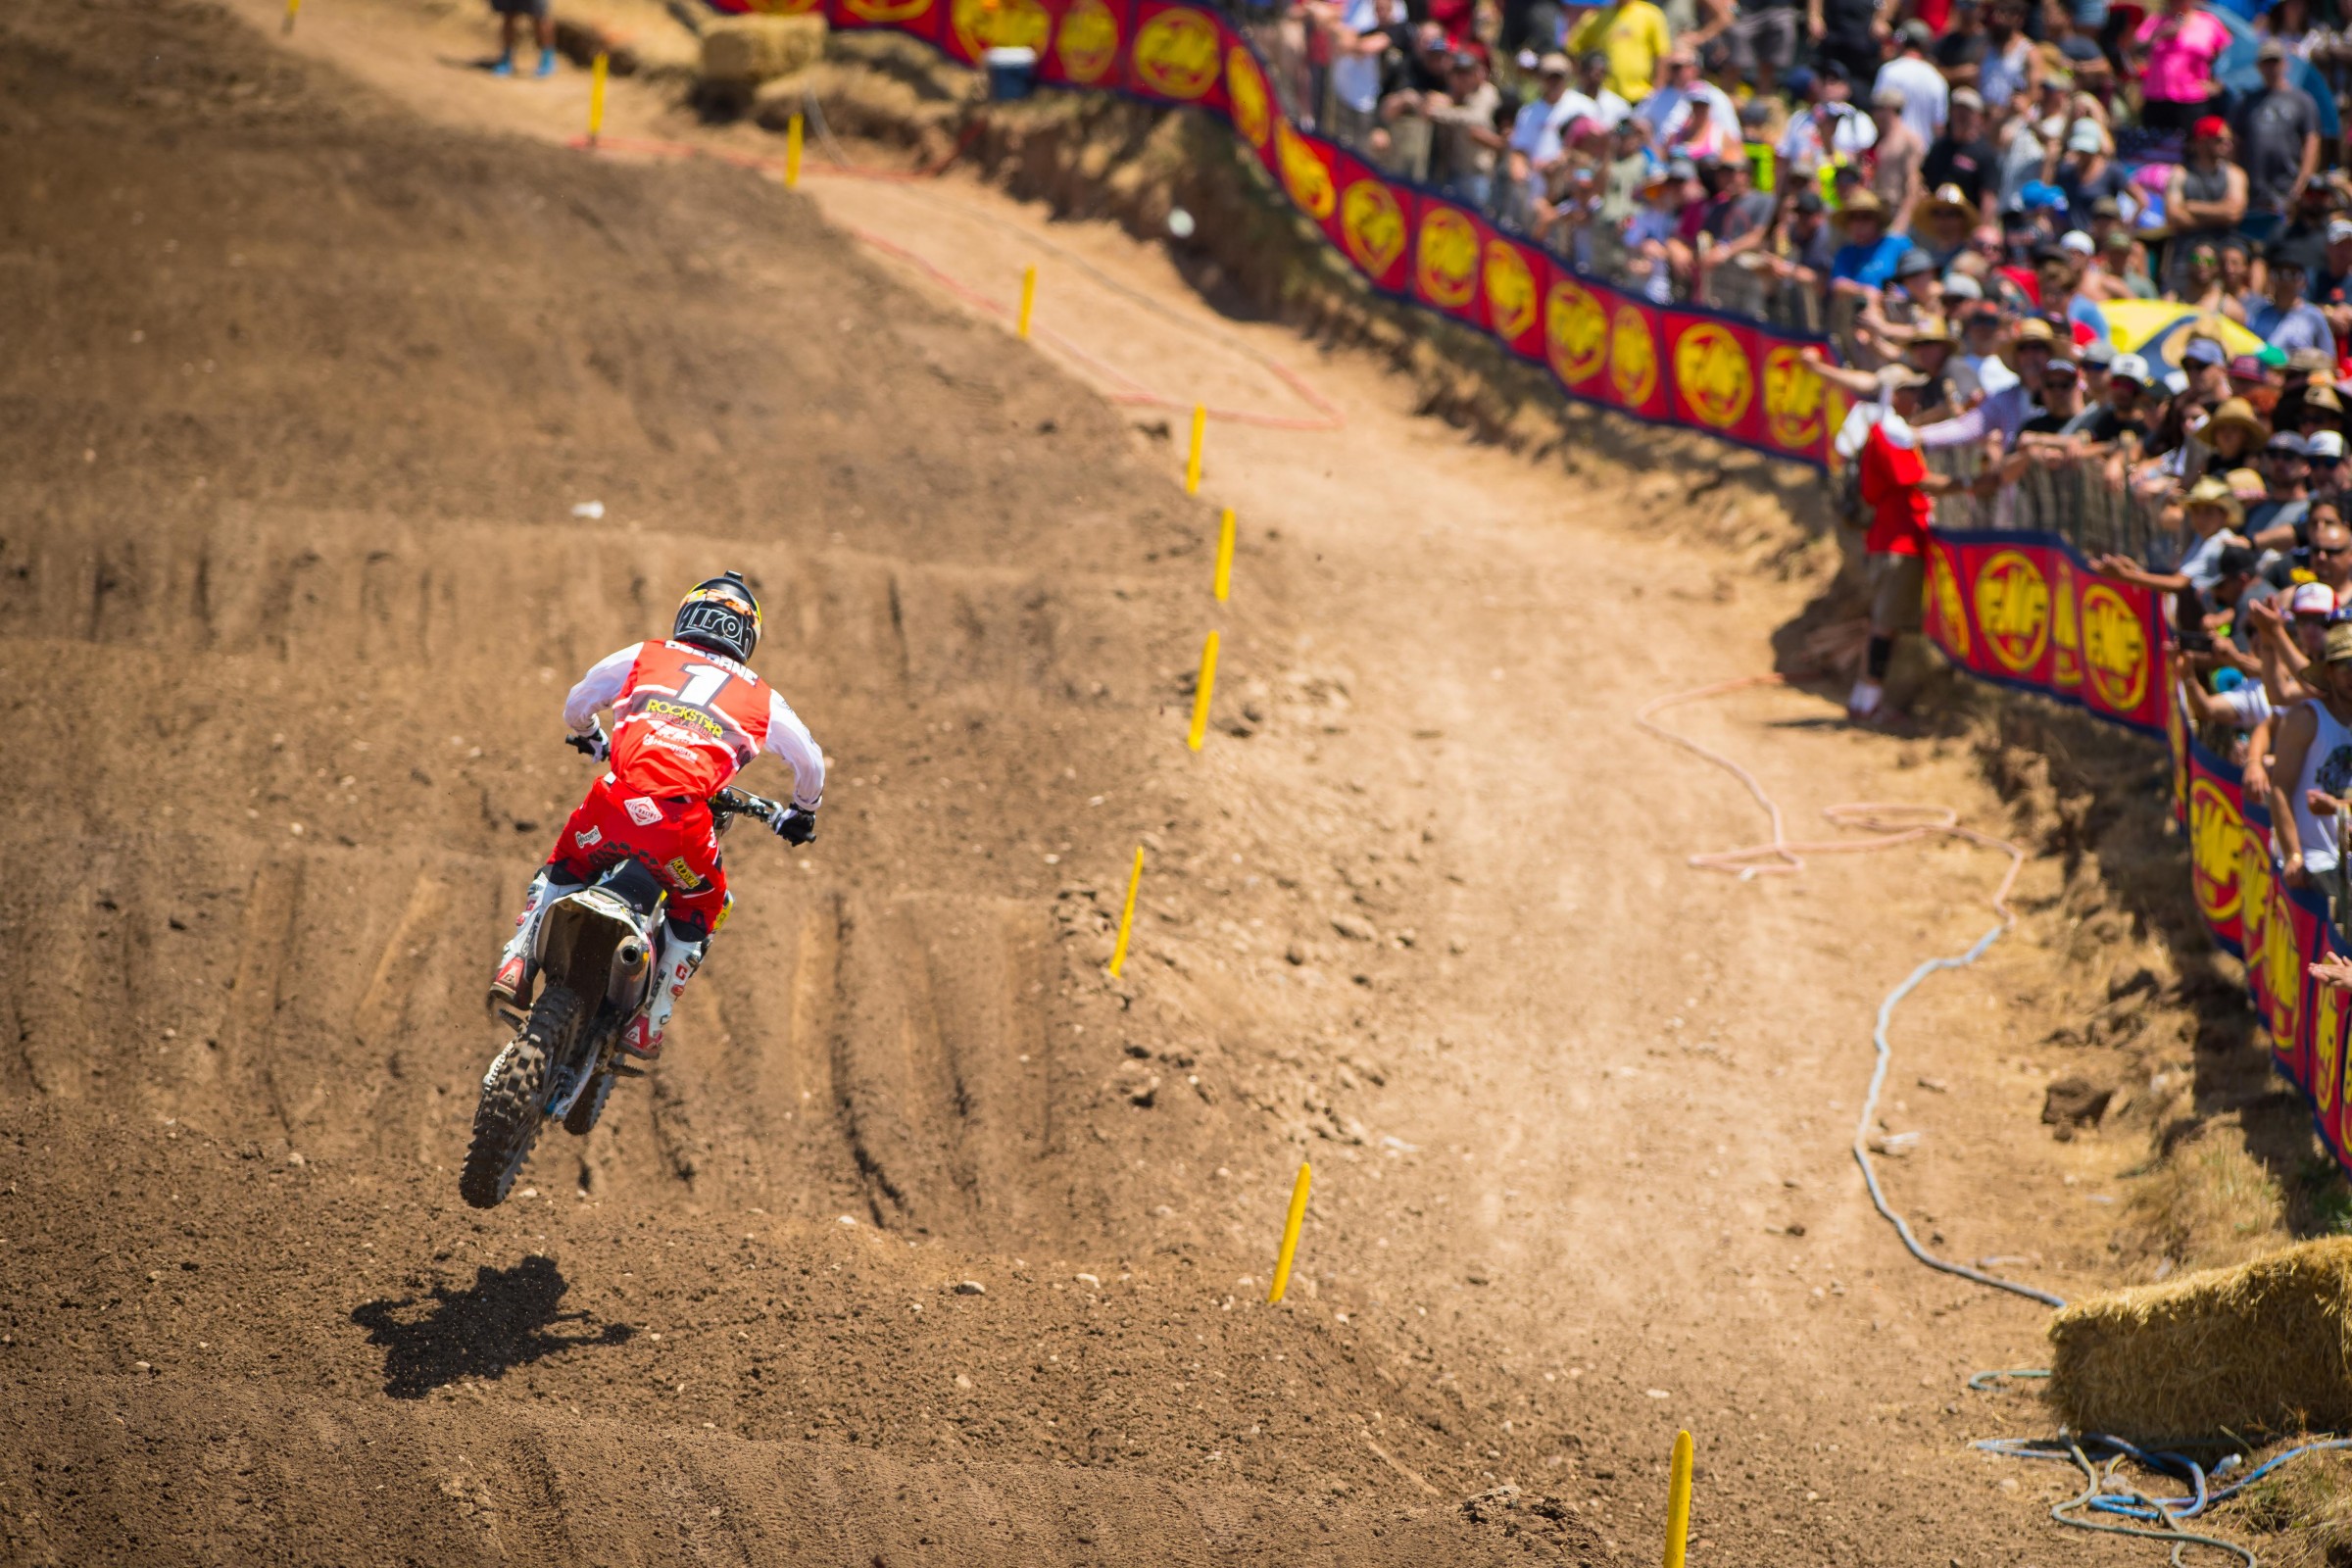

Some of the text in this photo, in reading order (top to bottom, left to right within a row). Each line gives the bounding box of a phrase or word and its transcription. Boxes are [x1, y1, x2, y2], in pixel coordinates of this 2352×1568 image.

[1981, 563, 2048, 636] FMF
[2082, 600, 2144, 677] FMF
[677, 663, 731, 707] 1
[647, 699, 723, 739] ROCKSTAR
